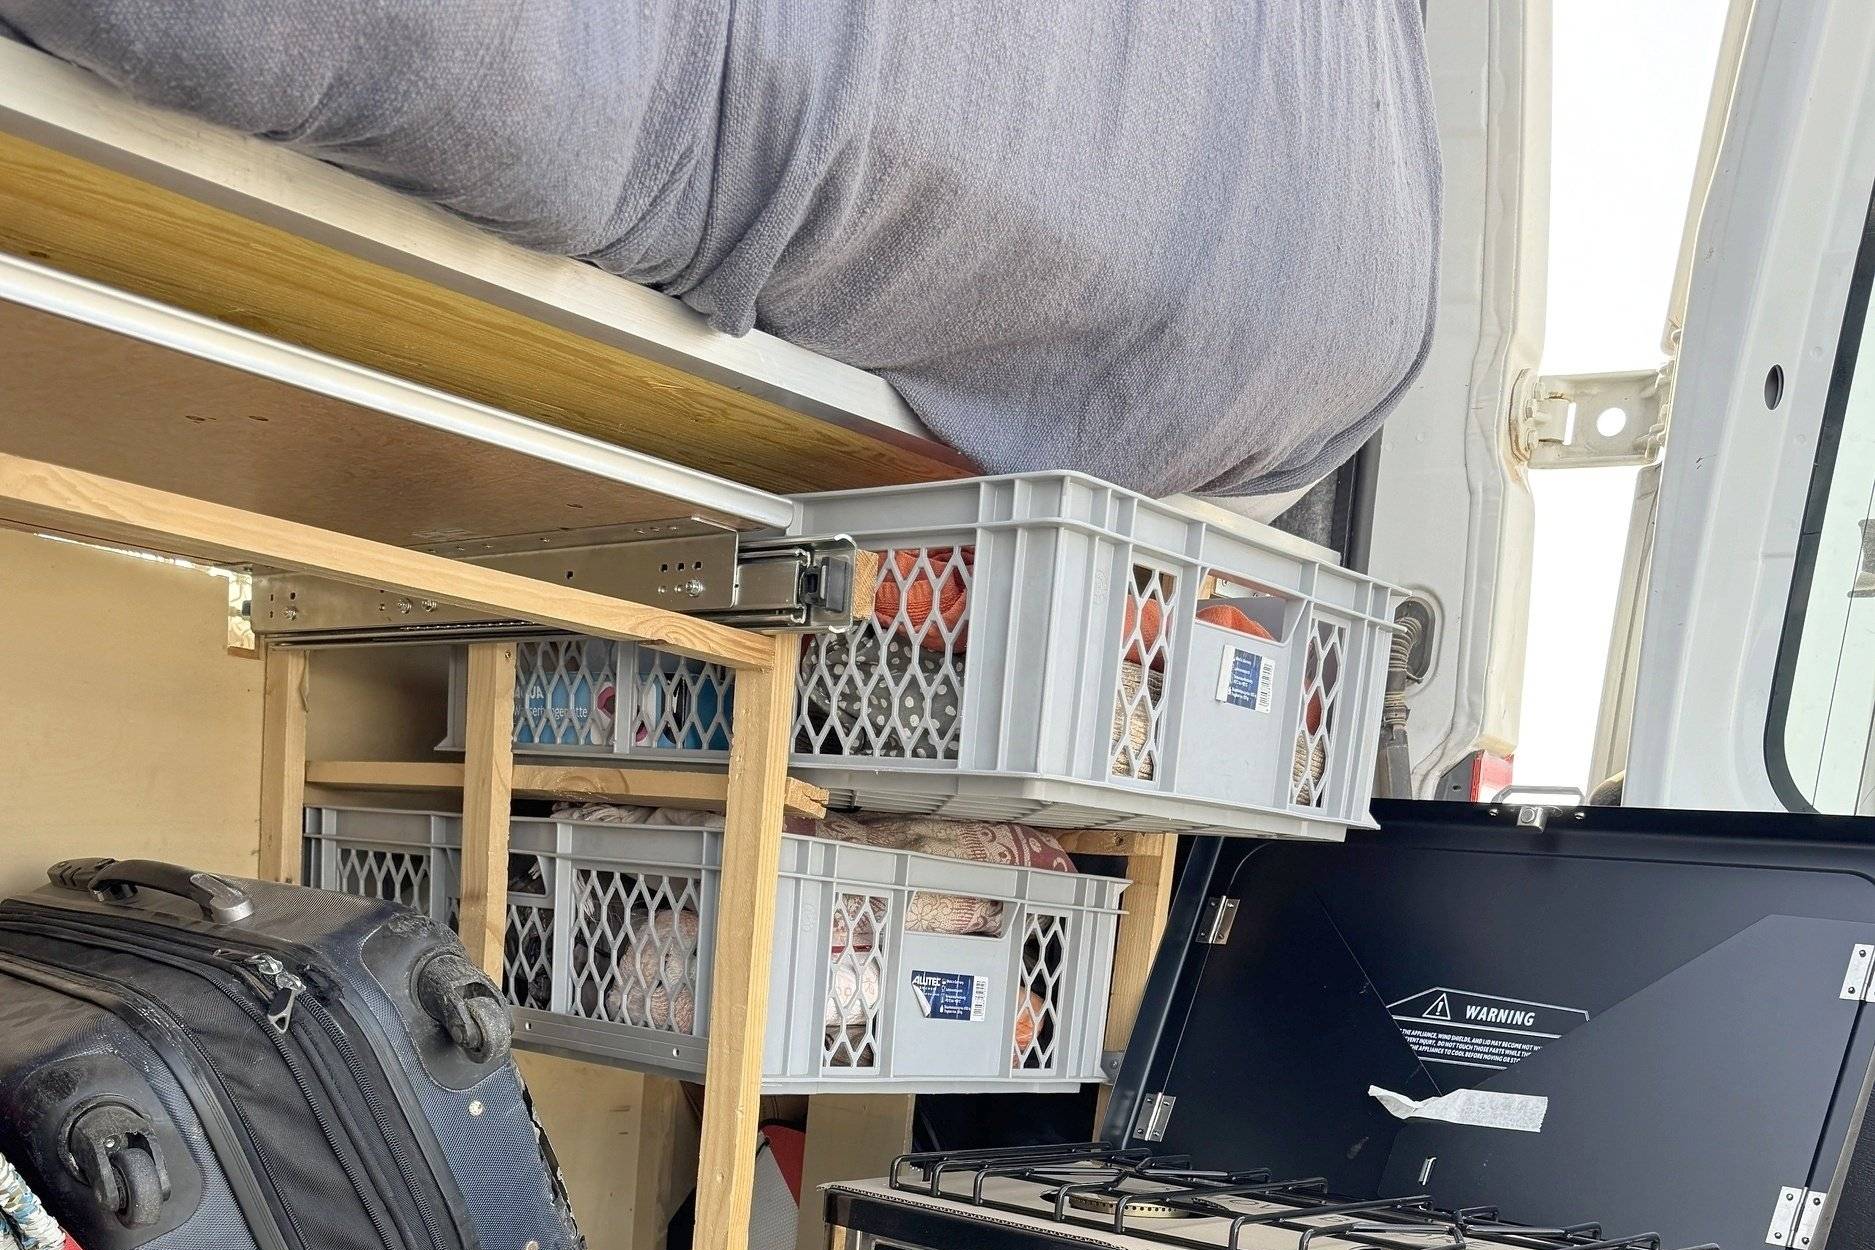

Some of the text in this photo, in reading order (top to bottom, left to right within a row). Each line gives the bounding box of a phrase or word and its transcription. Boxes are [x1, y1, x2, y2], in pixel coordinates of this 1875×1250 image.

[515, 686, 544, 699] AUA
[912, 975, 941, 987] ALUTEC
[1466, 1005, 1536, 1027] WARNING
[1402, 1028, 1412, 1036] THE
[1438, 1033, 1452, 1041] WIND
[1490, 1039, 1503, 1047] MAY
[1501, 1040, 1523, 1049] BECOME
[1522, 1043, 1534, 1051] HOT
[1418, 1045, 1444, 1054] APPLIANCE
[1464, 1051, 1483, 1060] BEFORE
[1482, 1053, 1503, 1062] MOVING
[1456, 1043, 1473, 1051] TOUCH
[1473, 1045, 1489, 1053] THOSE
[1489, 1047, 1505, 1055] PARTS
[1505, 1049, 1521, 1058] WHILE
